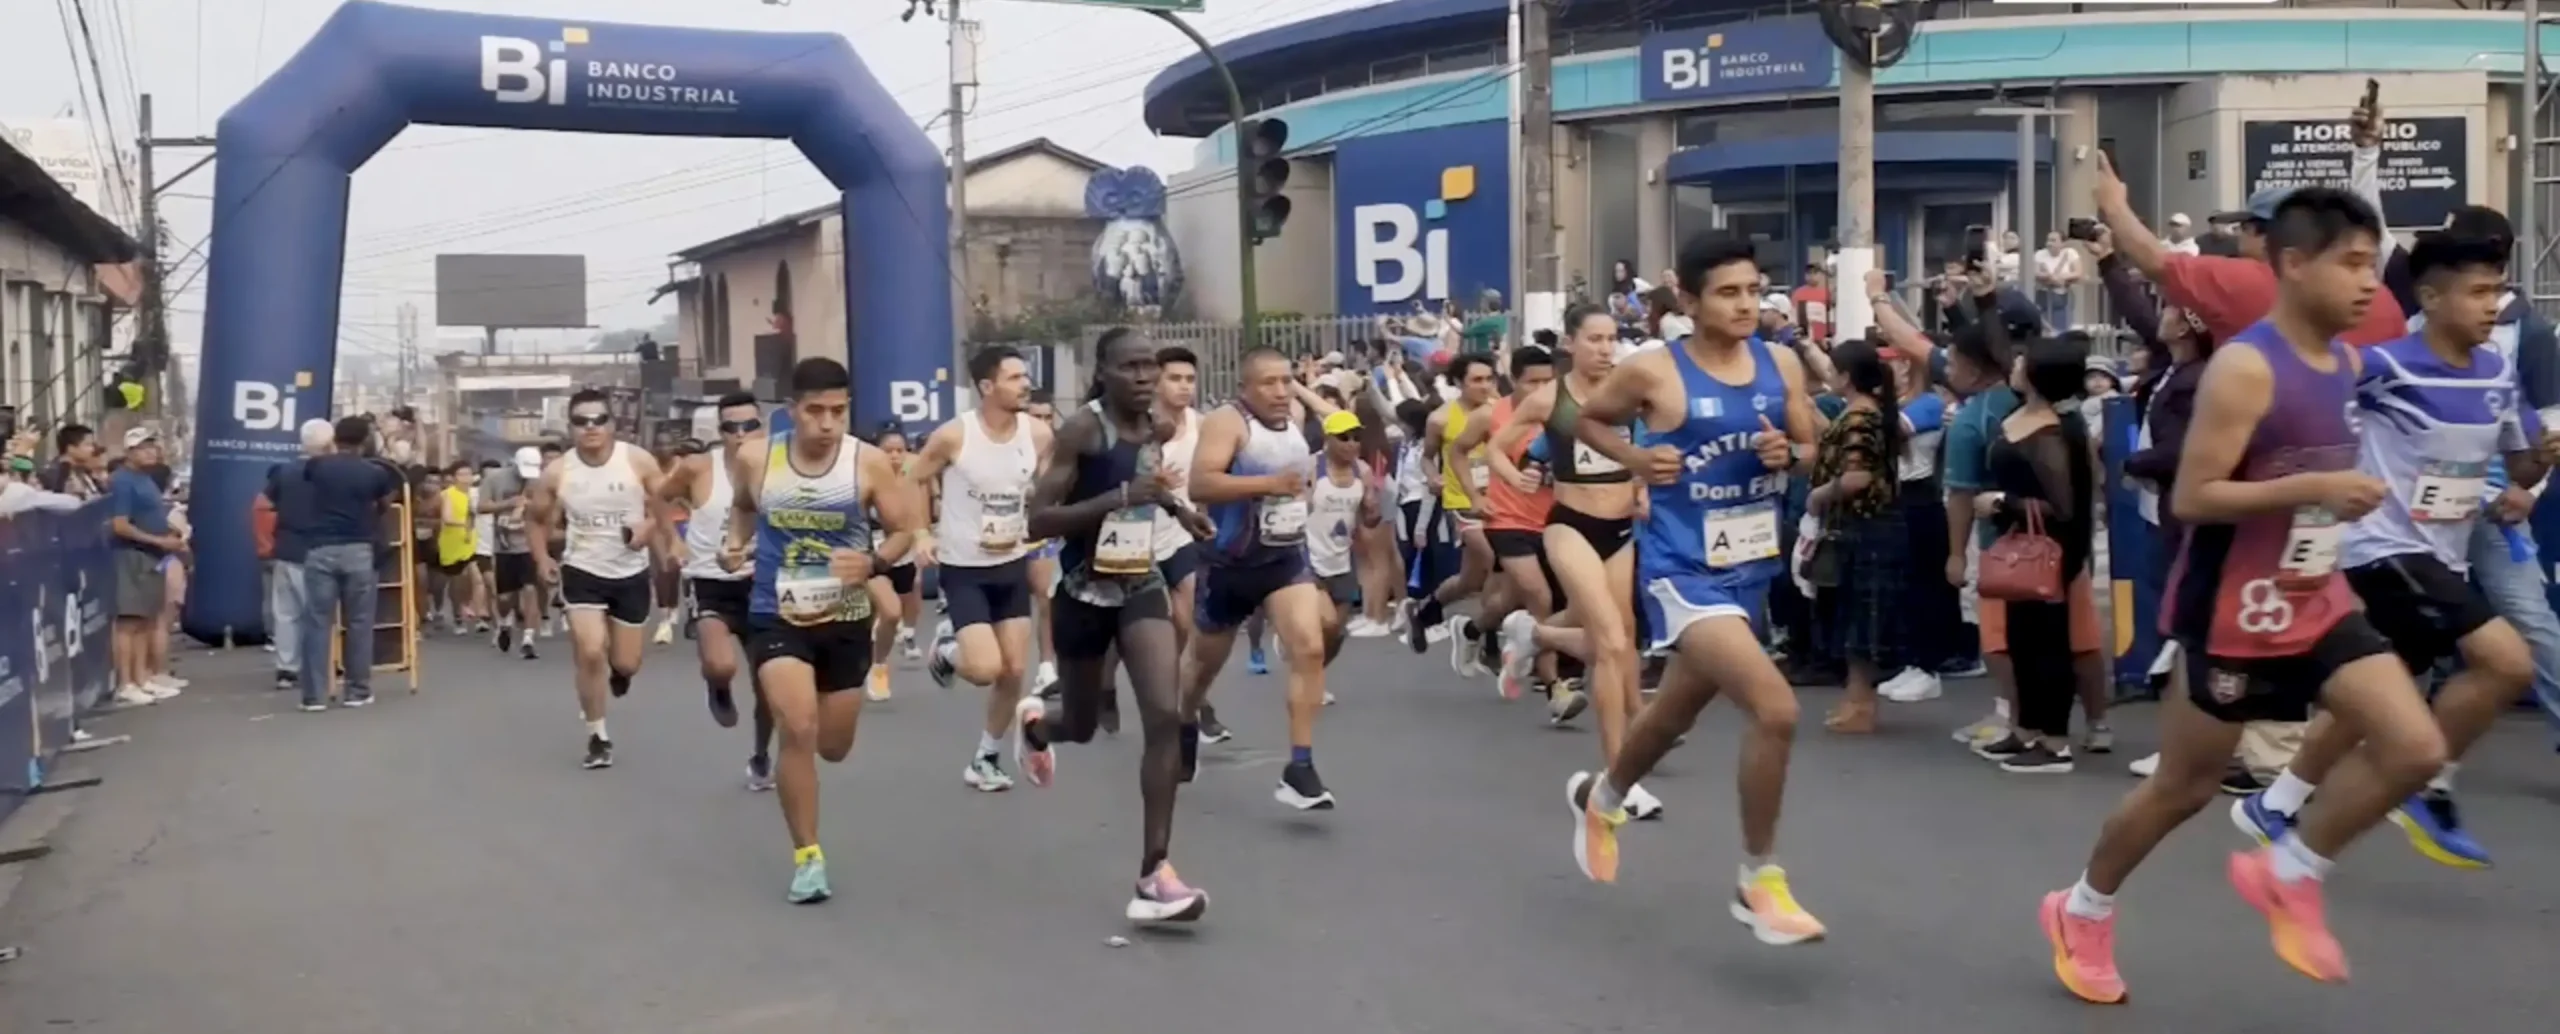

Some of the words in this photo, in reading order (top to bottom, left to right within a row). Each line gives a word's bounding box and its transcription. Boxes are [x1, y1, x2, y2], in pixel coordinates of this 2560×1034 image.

[481, 36, 567, 105] Bi
[587, 61, 676, 81] BANCO
[1663, 47, 1710, 89] Bi
[1720, 52, 1770, 66] BANCO
[1720, 62, 1806, 78] INDUSTRIAL
[587, 84, 740, 104] INDUSTRIAL
[2271, 144, 2289, 154] DE
[2383, 140, 2441, 151] PUBLICO
[1354, 199, 1449, 302] Bi
[233, 381, 297, 431] Bi
[889, 379, 940, 422] Bi
[208, 440, 247, 449] BANCO
[1578, 450, 1593, 465] A
[1690, 483, 1742, 500] Don
[2421, 486, 2440, 505] E
[1264, 511, 1276, 525] C
[983, 522, 996, 535] A
[1101, 530, 1119, 548] A
[1711, 530, 1731, 551] A
[2292, 540, 2313, 562] E
[781, 589, 796, 604] A
